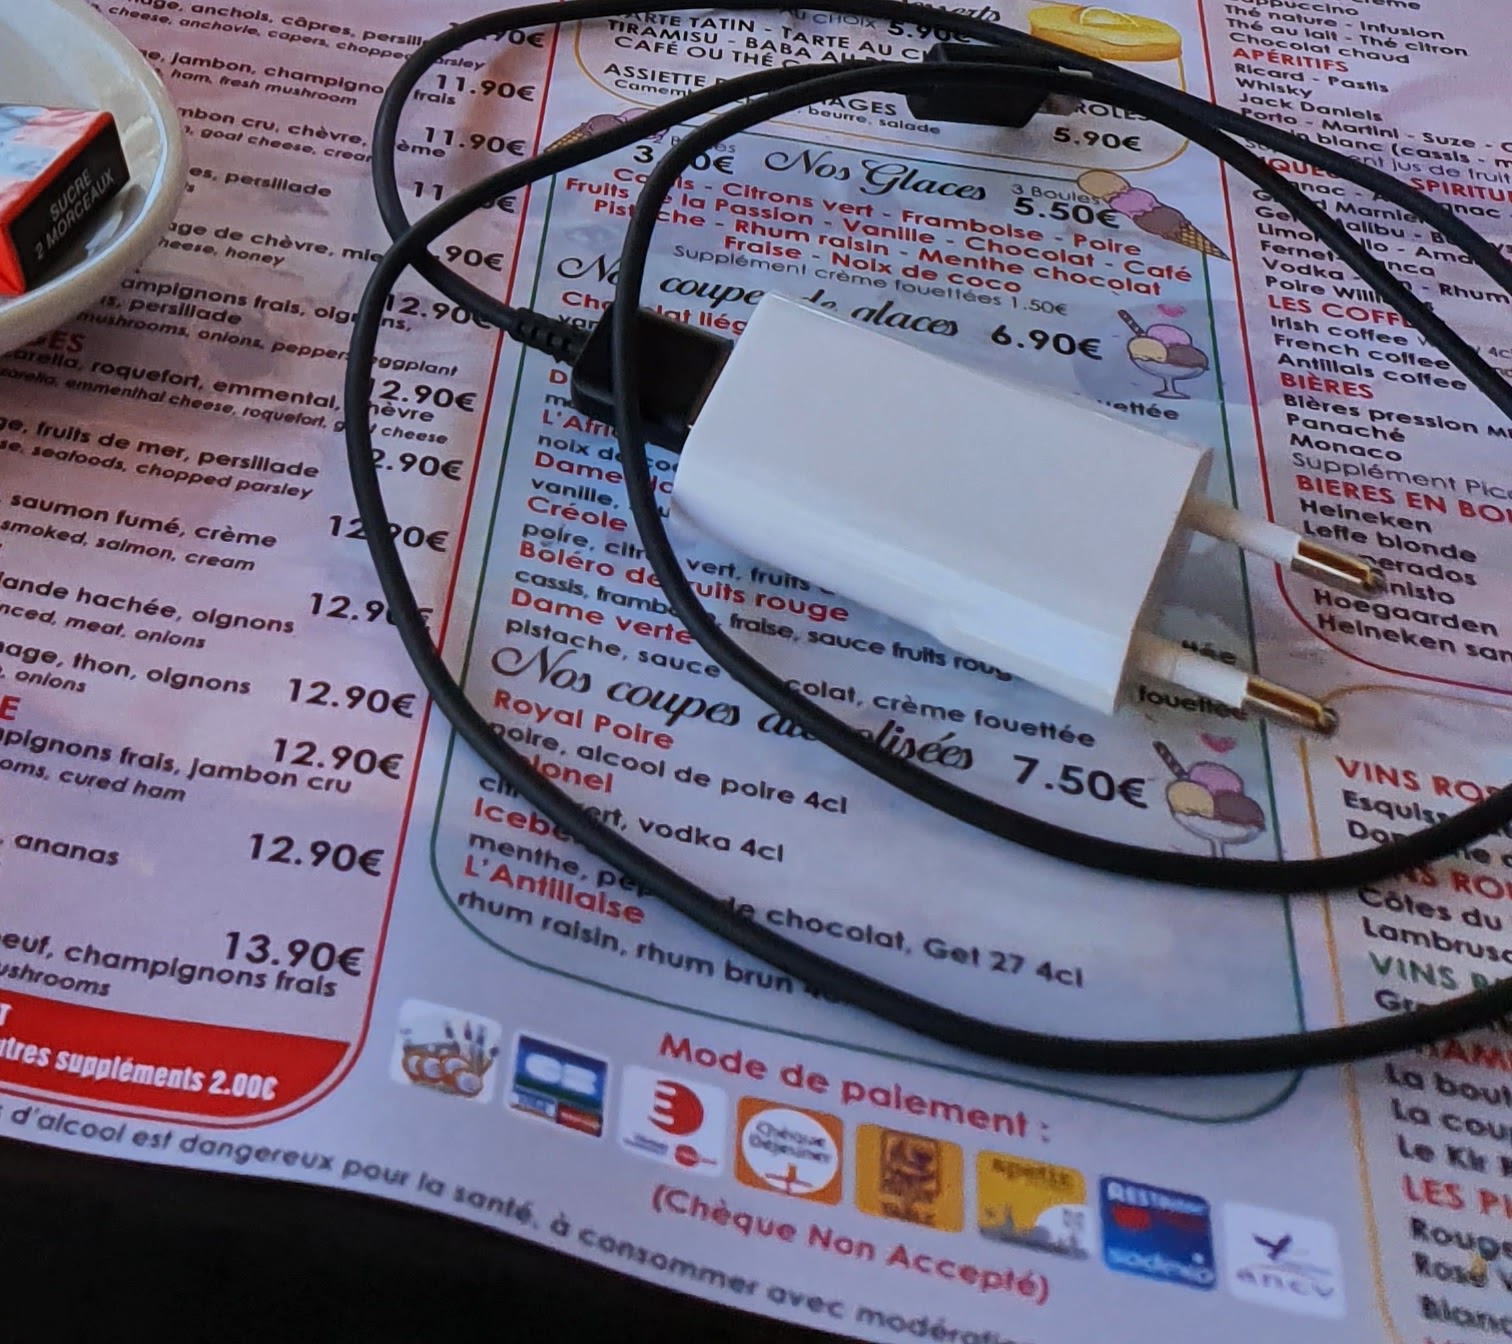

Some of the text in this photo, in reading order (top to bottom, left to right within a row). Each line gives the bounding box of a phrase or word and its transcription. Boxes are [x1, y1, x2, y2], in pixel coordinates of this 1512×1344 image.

[608, 19, 812, 59] TIRAMISU BABA
[689, 16, 850, 49] TATIN TARTE
[1229, 32, 1410, 64] Chocolat chaud
[604, 63, 705, 87] ASSIETTE
[1233, 46, 1349, 73] APÉRITIFS
[1236, 77, 1313, 98] Whisky
[1052, 126, 1142, 152] 5.90€
[763, 146, 987, 200] Nos Glaces
[565, 177, 629, 199] Fruits
[715, 196, 813, 226] Passion
[843, 218, 936, 245] Vanille
[965, 236, 1095, 268] Chocolat
[1123, 259, 1192, 284] Café
[722, 181, 1141, 256] Citrons vert Framboise Poire
[1013, 197, 1121, 229] 5.50€
[724, 235, 1022, 294] Fraise Noix de coco
[734, 219, 1161, 297] Rhum raisin Menthe chocolat
[991, 325, 1103, 362] 6.90€
[1280, 371, 1374, 400] BIÈRES
[1286, 413, 1406, 443] Panaché
[1290, 433, 1403, 463] Monaco
[10, 492, 109, 525] saumon
[115, 508, 186, 539] fumé,
[194, 524, 278, 549] crème
[527, 496, 628, 532] Créole
[1300, 499, 1432, 534] Heineken
[519, 540, 615, 577] Boléro
[76, 586, 184, 623] hachée,
[192, 607, 295, 635] oignons
[510, 587, 694, 645] Dame verte
[1314, 588, 1498, 636] Hoegaarden
[72, 651, 137, 682] thon,
[146, 666, 251, 696] oignons
[286, 678, 416, 714] 12.90€
[491, 646, 742, 728] Nos coupes
[493, 688, 675, 750] Royal Poire
[273, 737, 404, 780] 12.90€
[1011, 754, 1149, 810] 7.50€
[248, 832, 386, 877] 12.90€
[463, 855, 646, 925] L'Antillaise
[64, 943, 267, 990] champignons
[275, 971, 338, 998] frais
[225, 930, 366, 978] 13.90€
[54, 1047, 206, 1094] suppléments
[208, 1068, 280, 1101] 2.00€
[658, 1032, 1030, 1139] Mode de paiement
[11, 1102, 124, 1144] d'alcool
[131, 1126, 173, 1150] est
[180, 1132, 334, 1172] dangereux
[341, 1156, 410, 1185] pour
[417, 1170, 446, 1198] la
[454, 1180, 541, 1232] santé,
[549, 1211, 572, 1238] à
[577, 1226, 760, 1297] consommer
[652, 1183, 1050, 1307] (Chèque Non Accepté)
